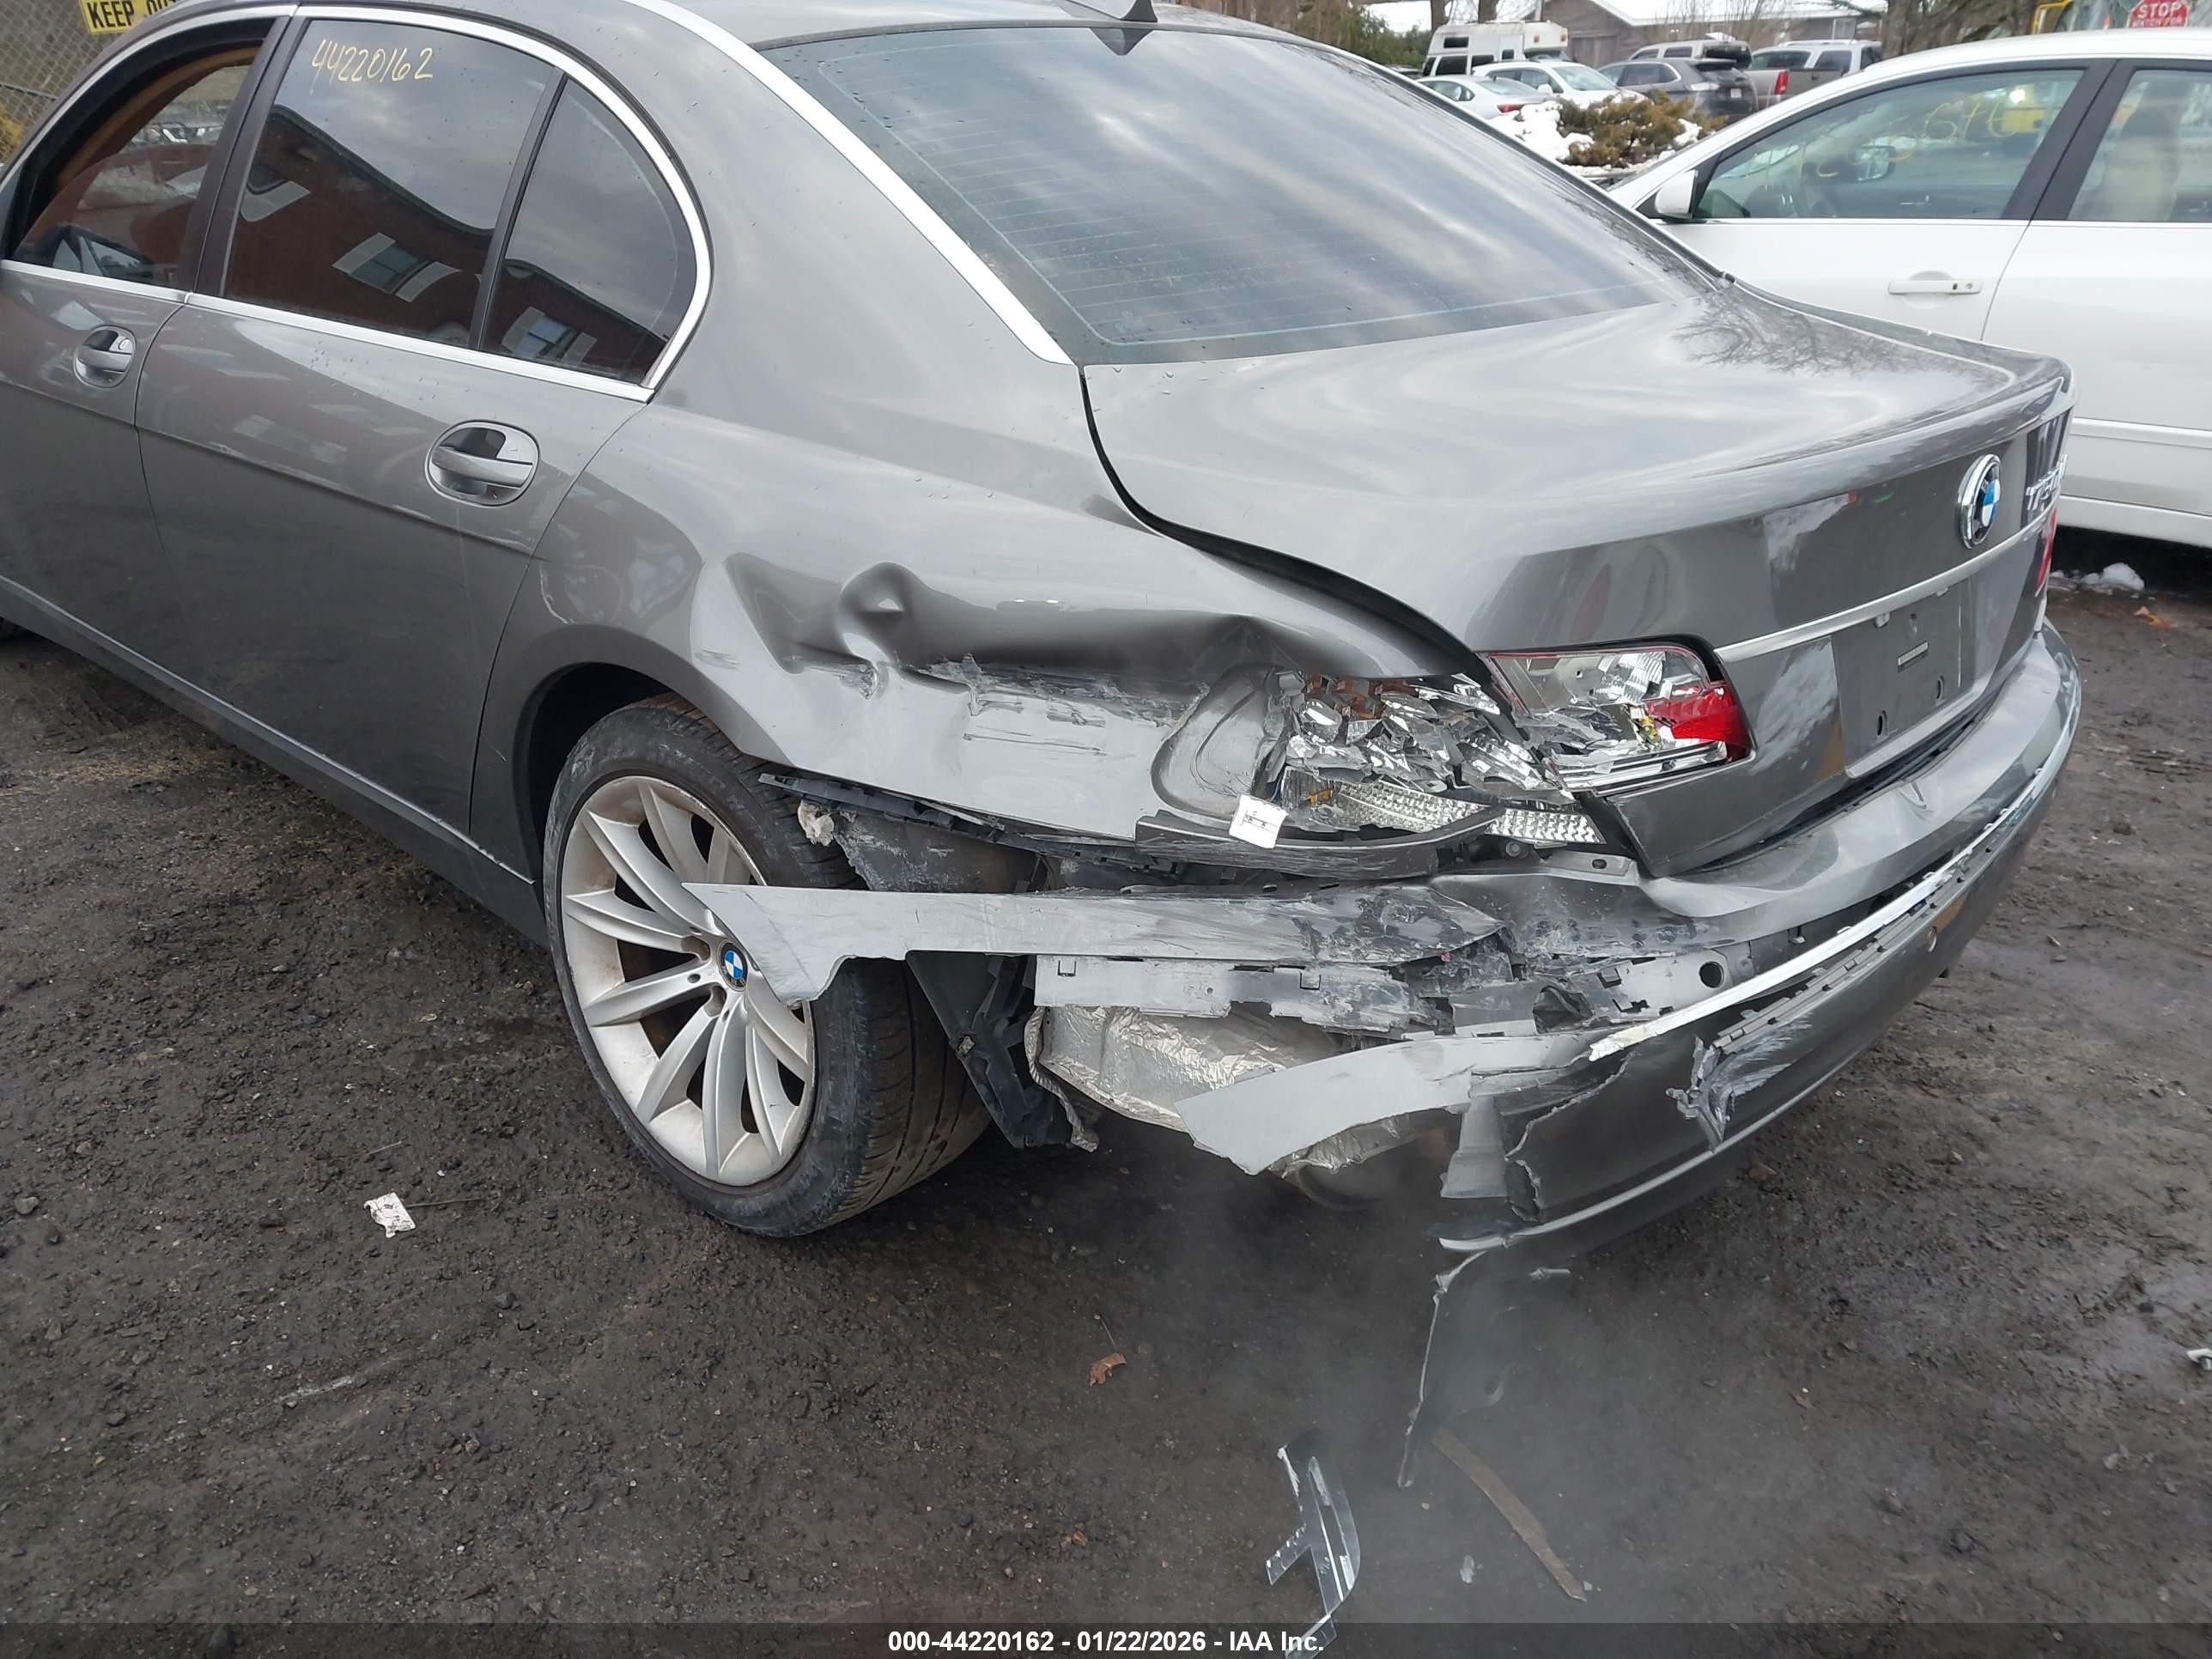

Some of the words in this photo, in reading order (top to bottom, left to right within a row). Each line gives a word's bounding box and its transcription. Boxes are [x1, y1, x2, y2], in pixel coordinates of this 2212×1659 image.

[86, 1, 135, 28] KEEP
[2137, 1, 2182, 19] STOP
[310, 39, 434, 95] 44220162
